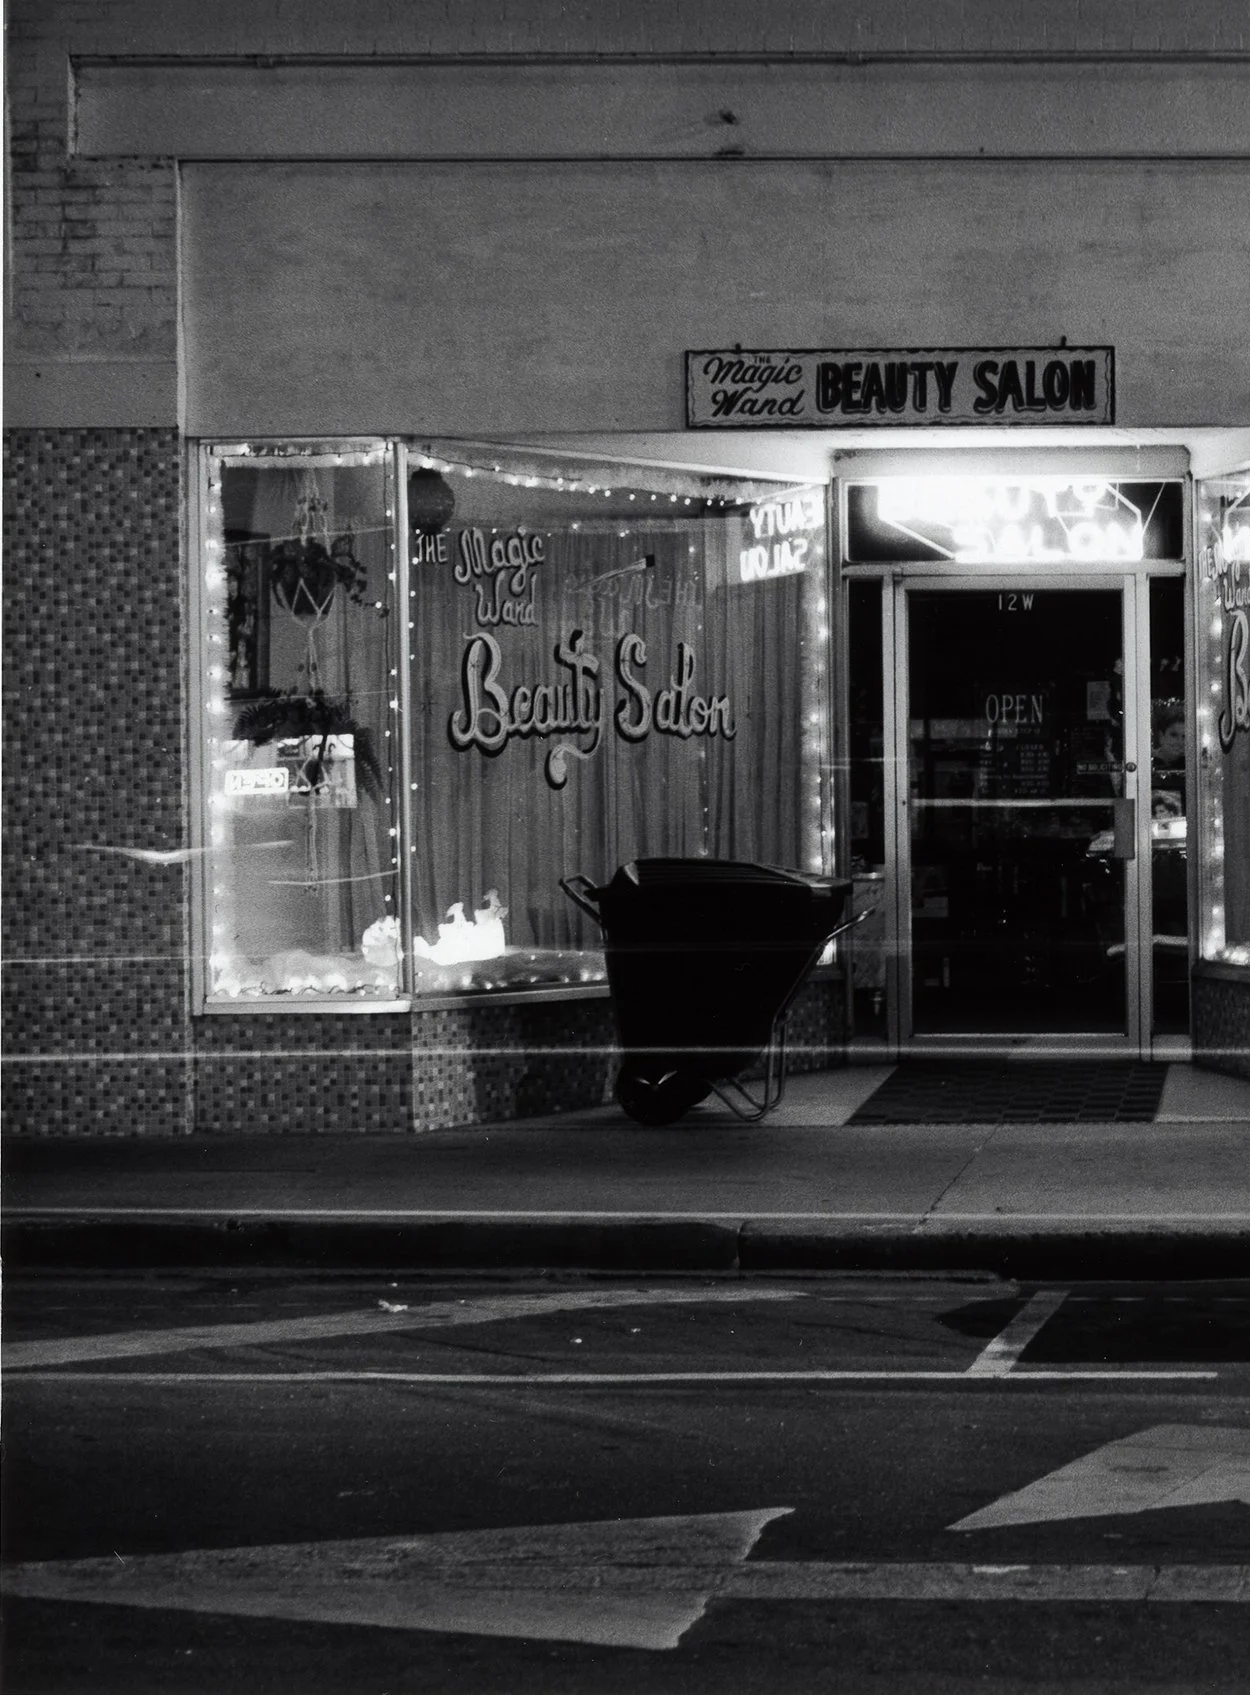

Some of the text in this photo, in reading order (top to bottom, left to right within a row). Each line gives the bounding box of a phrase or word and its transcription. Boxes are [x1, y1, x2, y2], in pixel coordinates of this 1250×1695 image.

[702, 355, 803, 393] Magic
[815, 359, 1097, 413] BEAUTY SALON
[710, 387, 804, 417] Wand
[417, 534, 449, 564] THE
[454, 527, 545, 596] Magic
[475, 573, 540, 627] Wand
[448, 630, 737, 790] Beauty Salon
[985, 693, 1043, 724] OPEN
